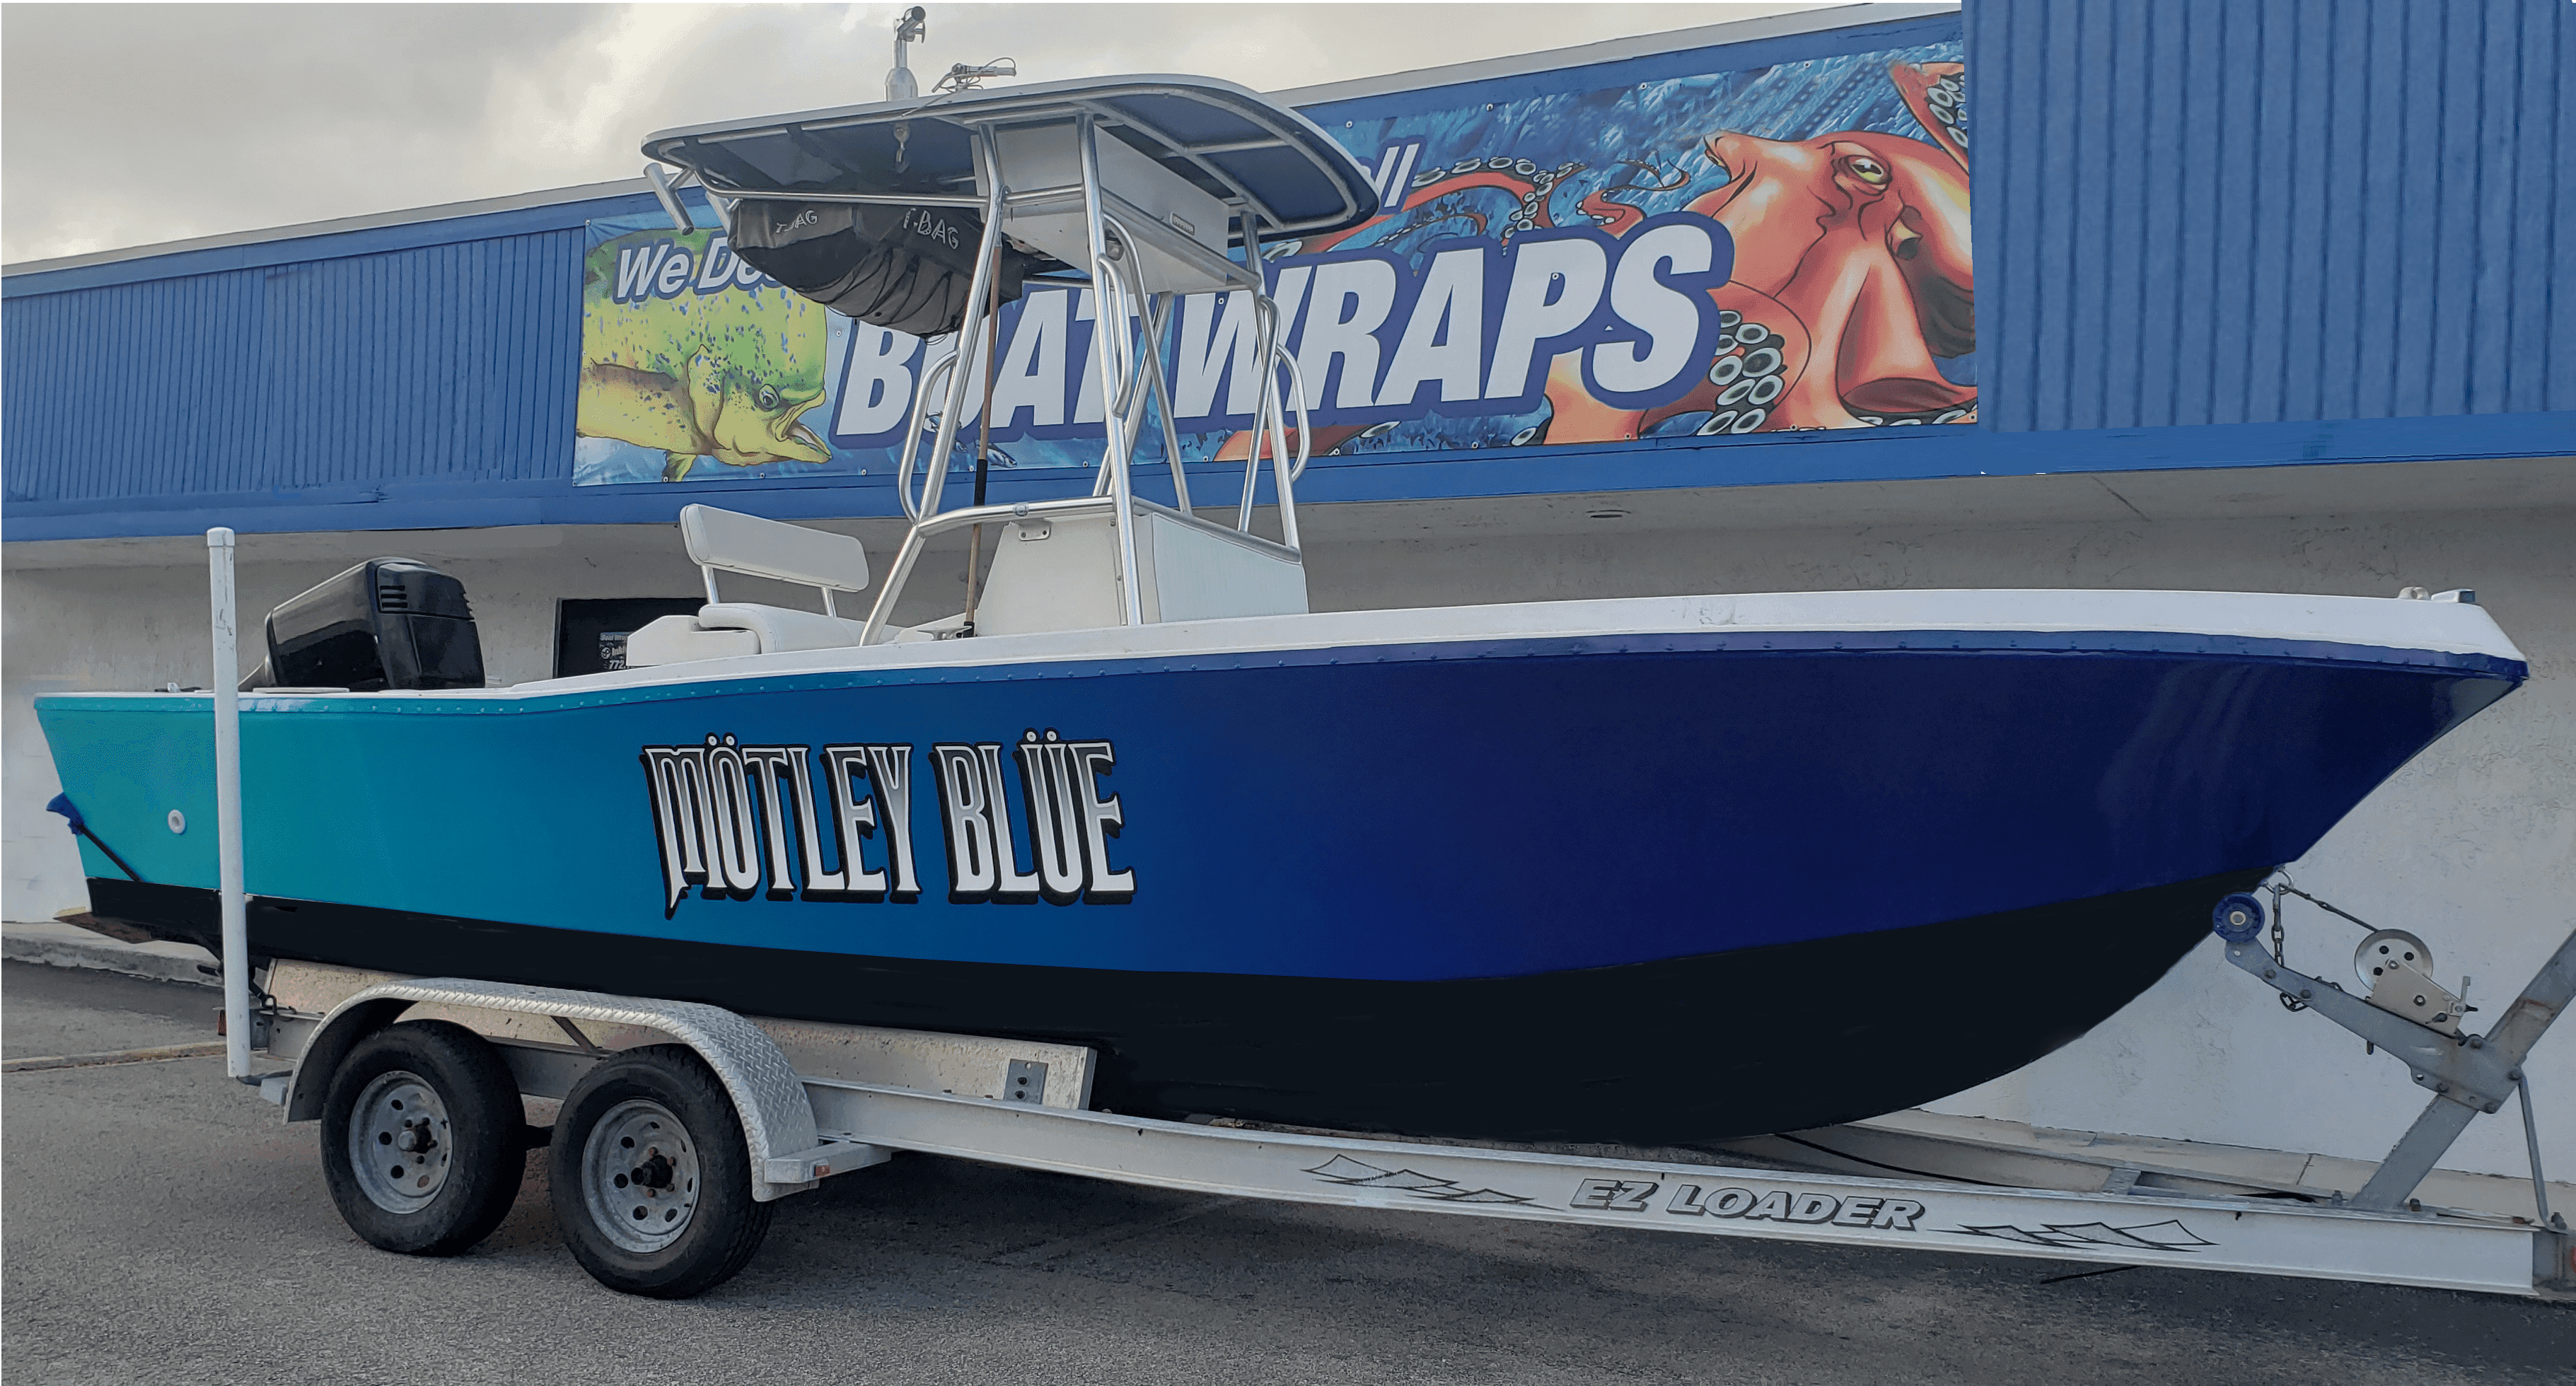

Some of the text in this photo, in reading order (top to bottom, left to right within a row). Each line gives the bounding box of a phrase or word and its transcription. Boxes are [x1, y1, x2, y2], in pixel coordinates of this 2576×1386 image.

[617, 237, 776, 298] We De
[1173, 223, 1712, 419] WRAPS
[641, 728, 1137, 919] MÖTLEY BLÜE
[1570, 1178, 1925, 1231] EZ LOADER
